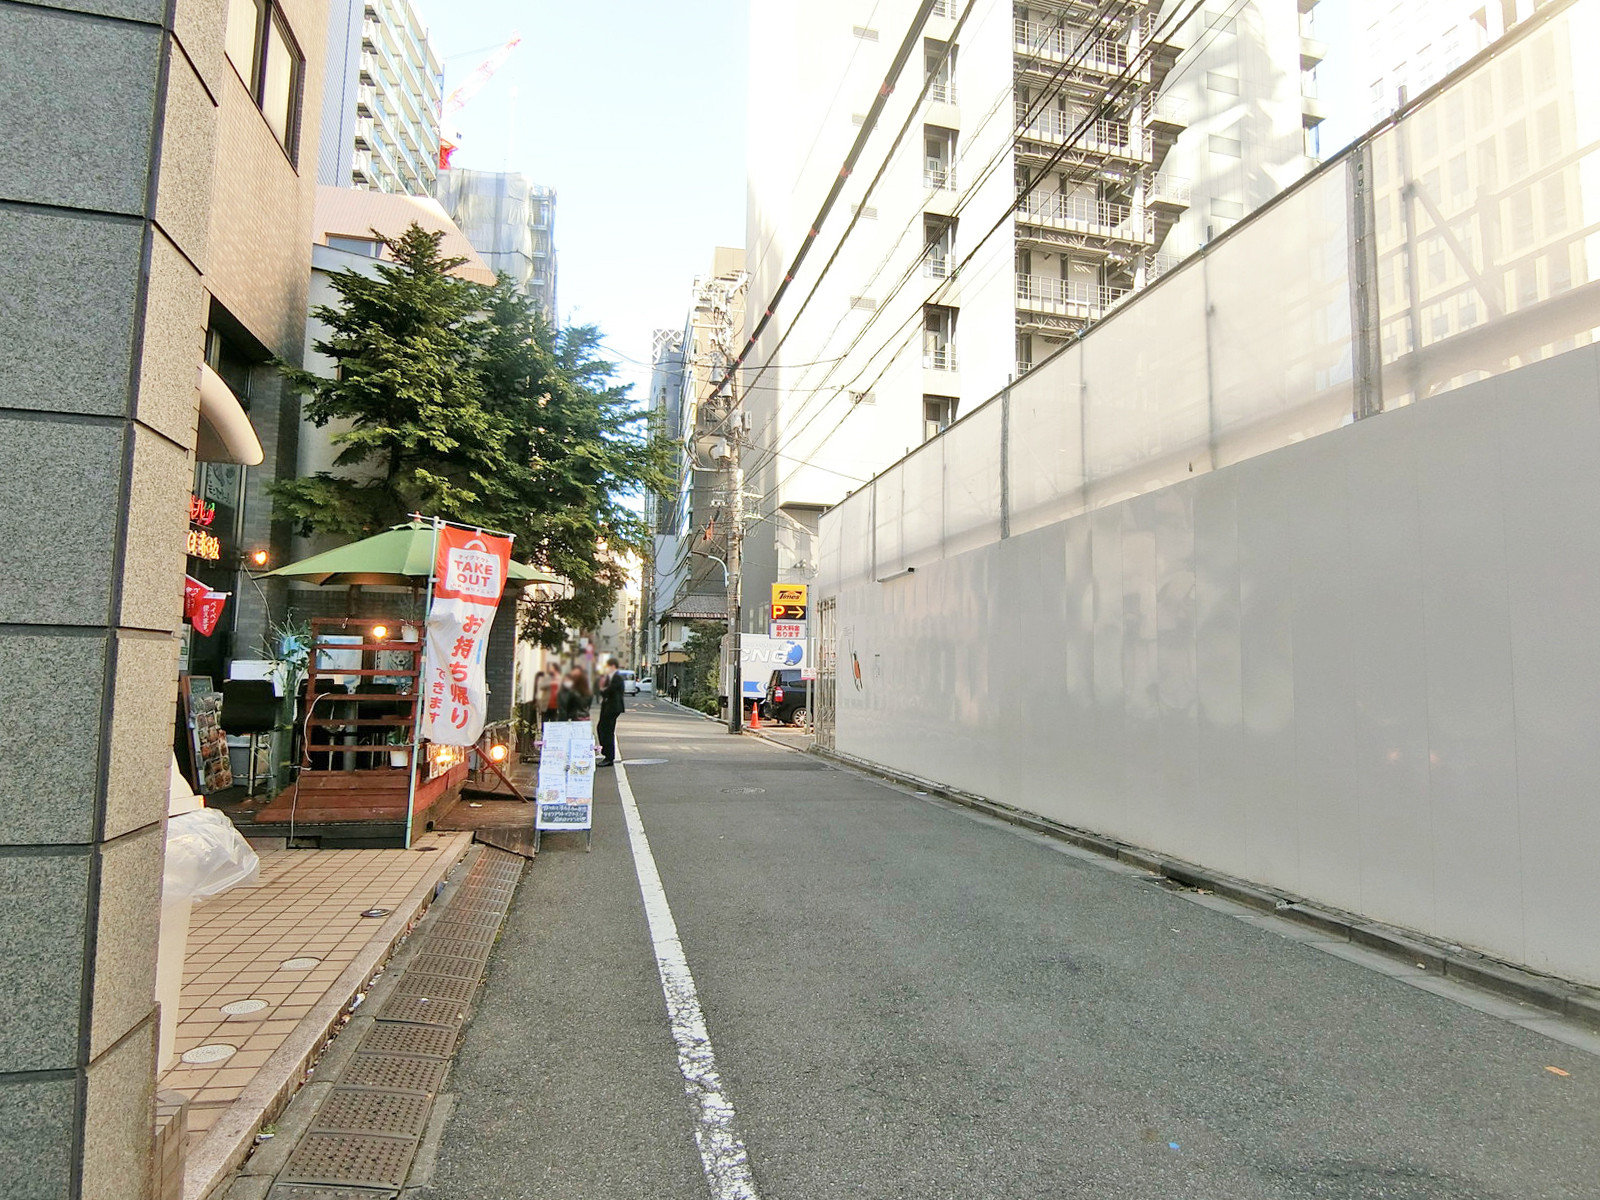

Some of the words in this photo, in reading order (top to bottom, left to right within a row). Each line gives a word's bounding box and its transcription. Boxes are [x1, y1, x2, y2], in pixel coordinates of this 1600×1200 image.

[454, 560, 493, 576] TAKE
[457, 573, 490, 587] OUT
[779, 590, 803, 600] Times
[773, 605, 785, 619] P
[449, 614, 485, 729] お持ち帰り
[429, 667, 446, 724] できます
